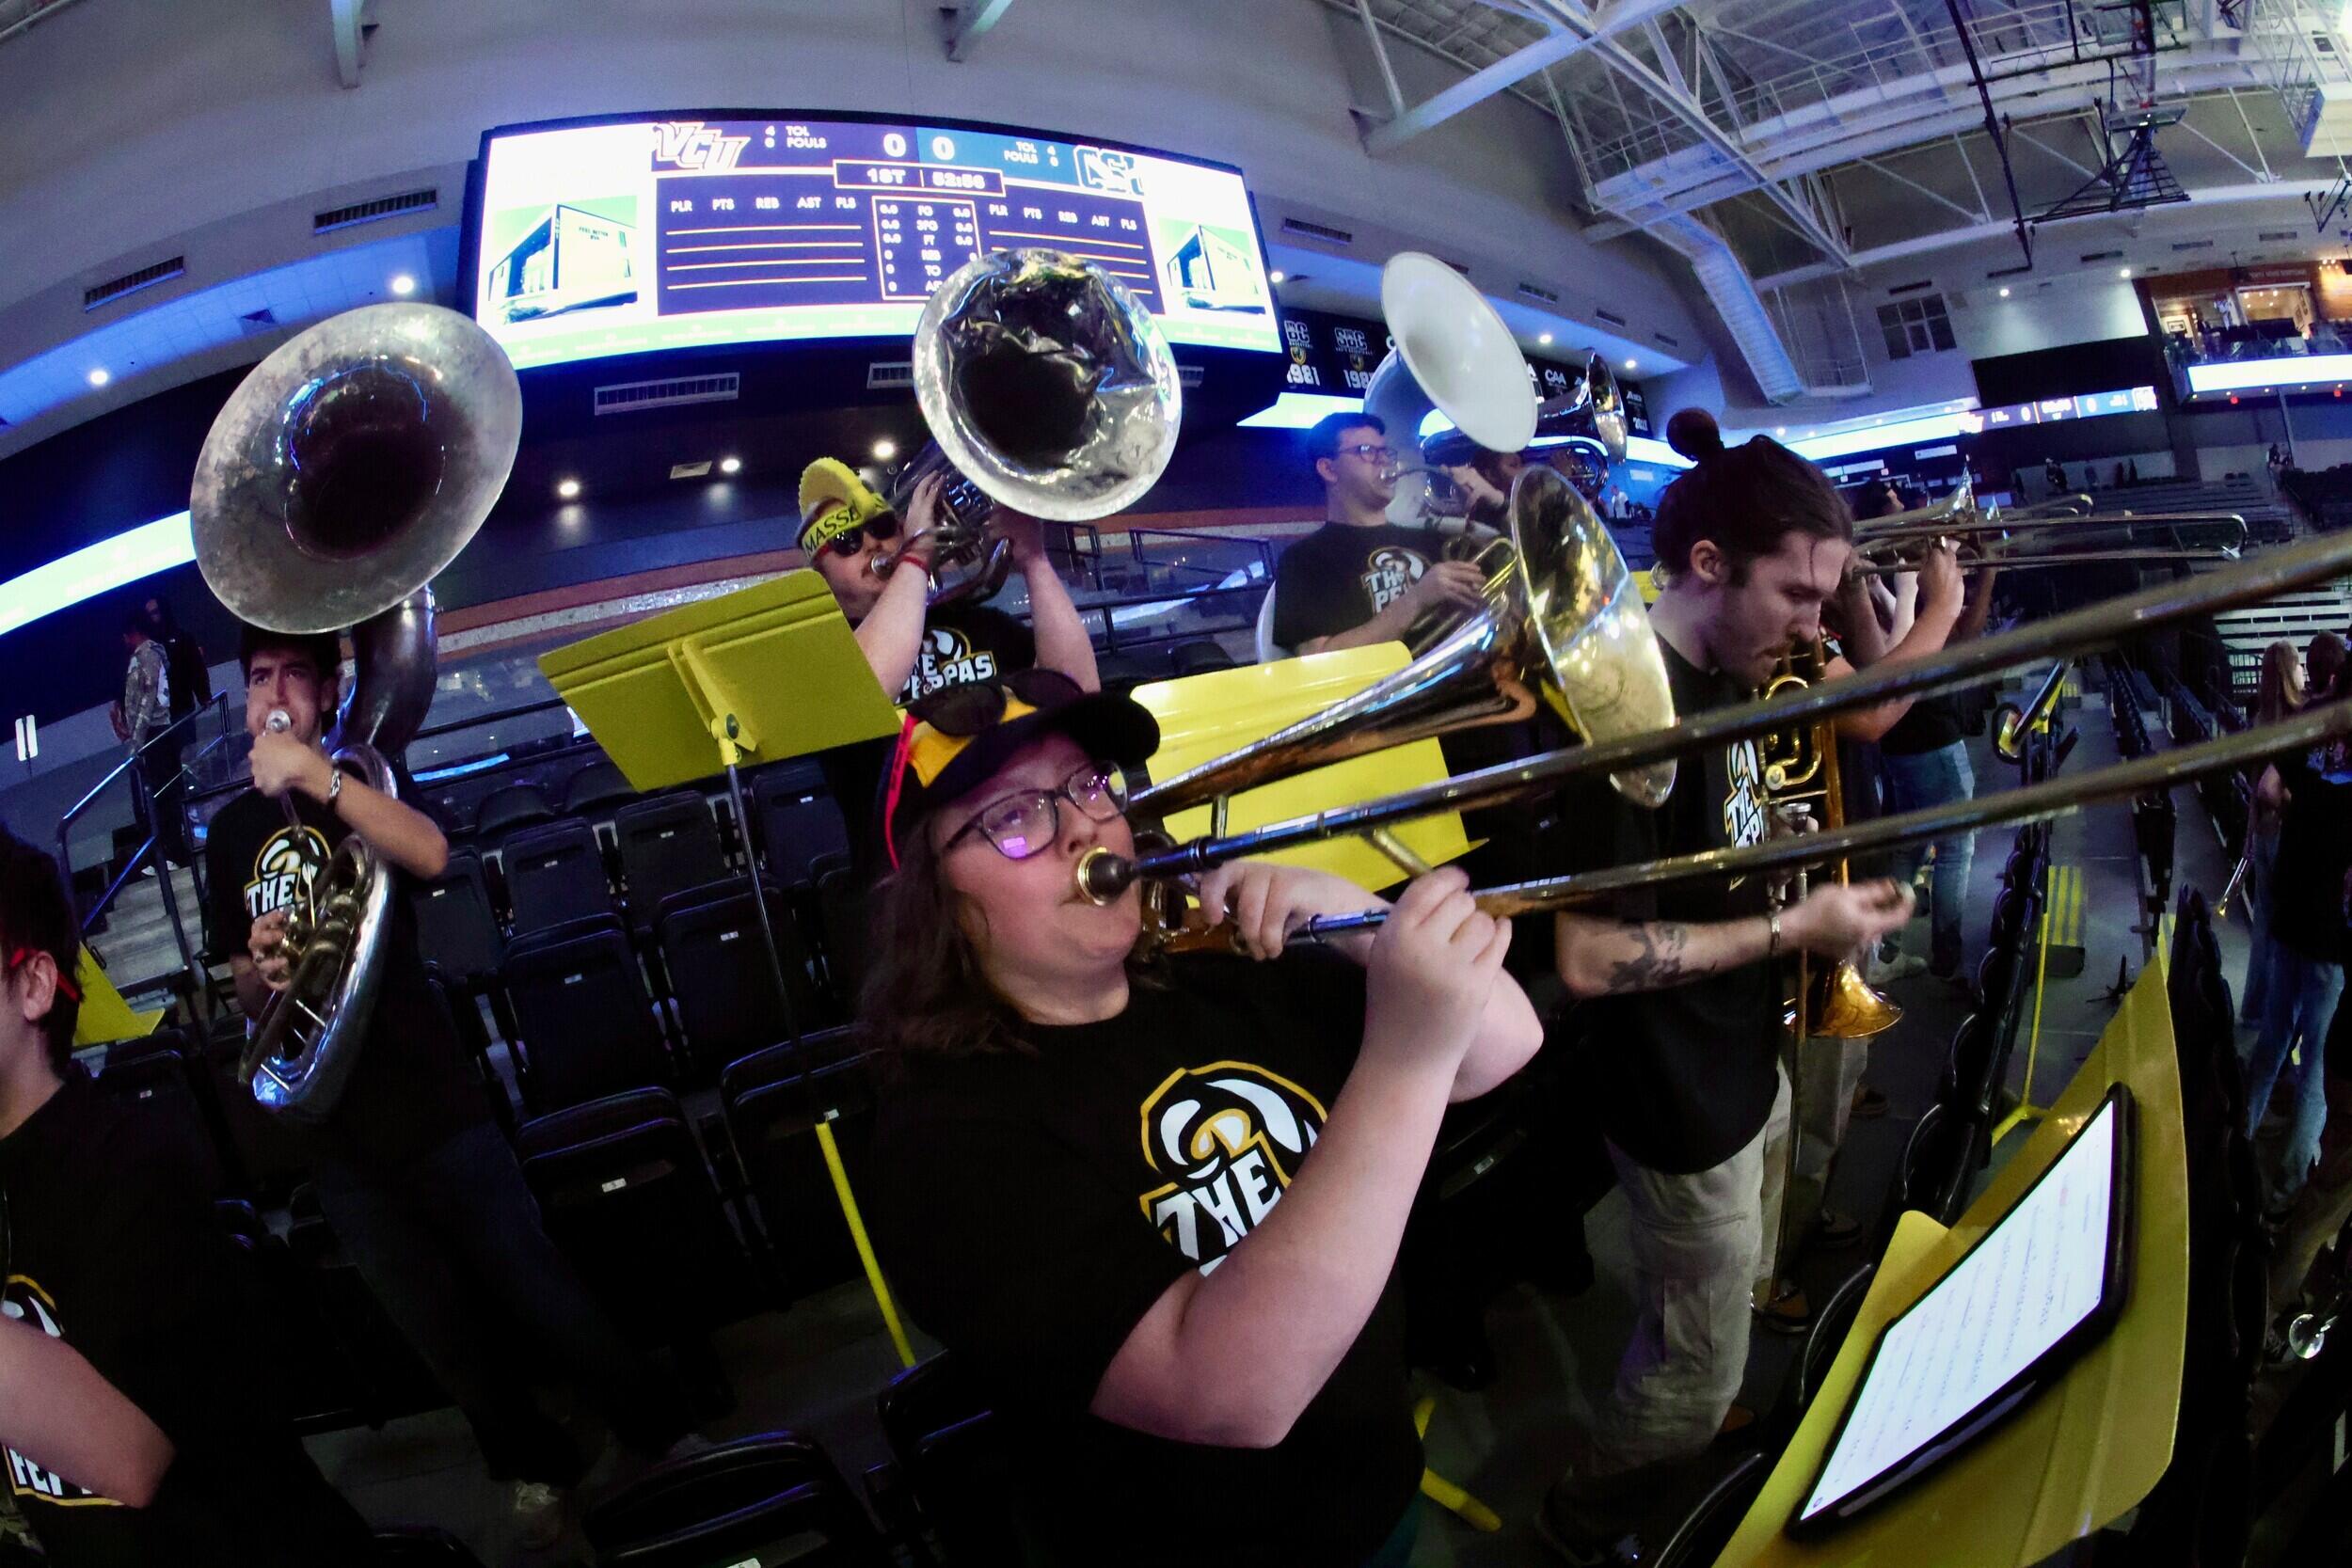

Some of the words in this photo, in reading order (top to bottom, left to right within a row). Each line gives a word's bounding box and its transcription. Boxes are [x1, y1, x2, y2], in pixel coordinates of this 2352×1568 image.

[765, 125, 776, 136] 4
[786, 125, 809, 136] TOL
[654, 120, 750, 169] VCU
[787, 137, 827, 149] FOULS
[883, 133, 906, 157] 0
[932, 136, 955, 160] 0
[1016, 141, 1037, 153] TOL
[1004, 150, 1039, 165] FOULS
[866, 168, 906, 183] 1ST
[671, 200, 692, 213] PLR
[712, 198, 735, 210] PTS
[756, 198, 780, 209] REB
[797, 197, 821, 209] AST
[836, 197, 856, 209] FLS
[880, 204, 898, 215] 0.0
[882, 219, 900, 230] 0.0
[990, 204, 1009, 216] PLR
[1024, 207, 1042, 219] PTS
[1058, 211, 1078, 224] REB
[1091, 214, 1110, 228] AST
[1120, 218, 1137, 230] FLS
[882, 233, 901, 244] 0.0
[884, 249, 893, 261] 0
[885, 263, 895, 274] 0
[925, 264, 942, 277] TO
[888, 281, 897, 292] 0
[1287, 364, 1320, 386] 1981
[1726, 775, 1754, 842] THE
[246, 874, 296, 919] THE
[1156, 1148, 1281, 1261] THE
